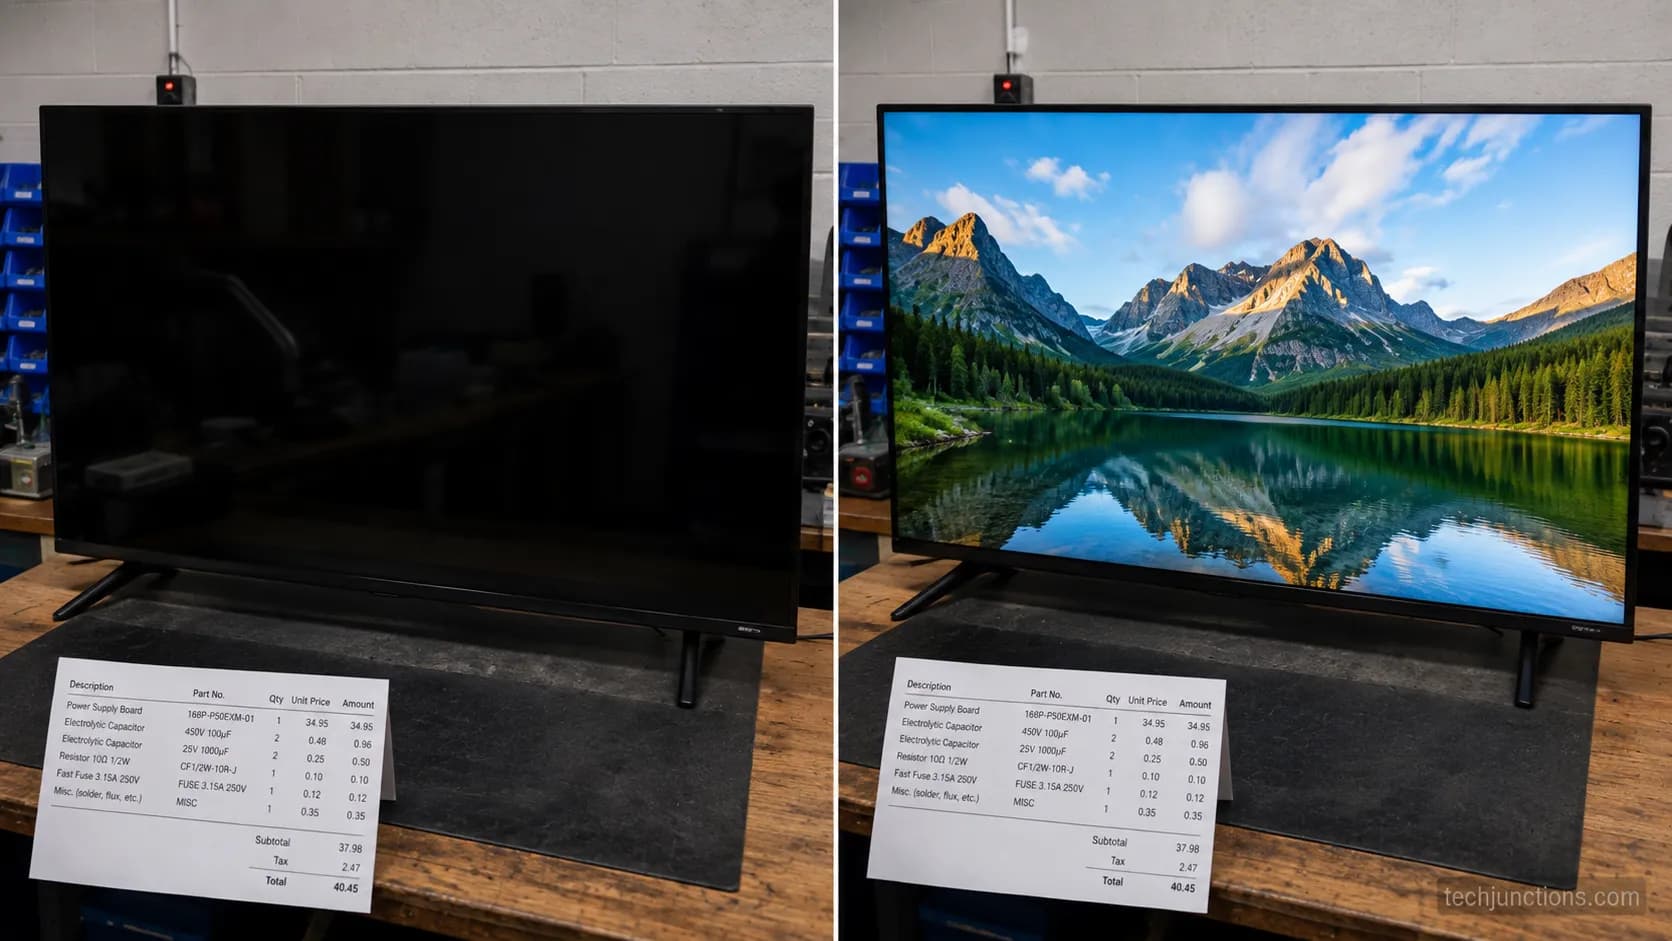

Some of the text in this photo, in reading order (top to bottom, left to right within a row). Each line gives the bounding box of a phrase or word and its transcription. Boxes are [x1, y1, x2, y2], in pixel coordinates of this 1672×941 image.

[70, 680, 114, 693] Description
[907, 680, 951, 693] Description
[193, 689, 224, 700] Part No.
[269, 694, 285, 705] Qty
[1031, 688, 1062, 700] Part No.
[1106, 694, 1120, 705] Qty
[66, 701, 143, 715] Power Supply Board
[290, 696, 330, 708] Unit Price
[342, 699, 374, 710] Amount
[904, 700, 980, 716] Power Supply Board
[1128, 696, 1168, 708] Unit Price
[1178, 699, 1212, 710] Amount
[276, 716, 281, 724] 1
[1024, 709, 1091, 724] 168P-P50EXM-01
[1113, 716, 1118, 725] 1
[1142, 717, 1167, 728] 34.95
[64, 717, 144, 734] Electrolytic Capacitor
[306, 718, 328, 729] 34.95
[350, 720, 375, 733] 34.95
[902, 717, 983, 734] Electrolytic Capacitor
[1186, 720, 1210, 733] 34.95
[185, 727, 232, 741] 450V 100µF
[274, 733, 280, 742] 2
[1021, 728, 1070, 741] 450V 100µF
[1111, 734, 1117, 742] 2
[62, 734, 142, 751] Electrolytic Capacitor
[308, 735, 326, 747] 0.48
[352, 738, 372, 750] 0.96
[899, 734, 980, 751] Electrolytic Capacitor
[1145, 736, 1165, 746] 0.48
[1191, 738, 1208, 750] 0.96
[182, 744, 229, 758] 25V 1000µF
[272, 751, 278, 760] 2
[1019, 743, 1066, 758] 25V 1000µF
[1108, 751, 1115, 760] 2
[59, 751, 131, 767] Resistor 10Ω 1/2W
[307, 753, 325, 765] 0.25
[352, 756, 370, 768] 0.50
[897, 750, 968, 767] Resistor 10Ω 1/2W
[1144, 753, 1161, 765] 0.25
[1189, 756, 1207, 768] 0.50
[56, 768, 74, 778] Fast
[75, 770, 94, 780] Fuse
[118, 774, 140, 784] 250V
[271, 768, 276, 777] 1
[305, 771, 324, 781] 0.10
[894, 768, 977, 784] Fast Fuse 3.15A 250V
[1108, 768, 1113, 777] 1
[1142, 771, 1160, 782] 0.10
[351, 775, 369, 784] 0.10
[1188, 774, 1207, 784] 0.10
[178, 779, 247, 792] FUSE 3.15A 250V
[269, 786, 274, 795] 1
[1016, 779, 1084, 792] FUSE 3.15A 250V
[1106, 786, 1111, 795] 1
[54, 785, 142, 804] Misc. (solder, flux, etc.)
[303, 788, 321, 800] 0.12
[349, 791, 367, 804] 0.12
[891, 785, 979, 804] Misc. (solder, flux, etc.)
[1140, 788, 1158, 800] 0.12
[1186, 792, 1205, 804] 0.12
[176, 797, 198, 808] MISC
[1013, 796, 1035, 807] MISC
[267, 803, 272, 813] 1
[301, 806, 320, 817] 0.35
[1104, 804, 1109, 813] 1
[1138, 807, 1156, 817] 0.35
[347, 809, 366, 820] 0.35
[1184, 809, 1202, 821] 0.35
[255, 835, 291, 848] Subtotal
[1092, 835, 1128, 848] Subtotal
[339, 843, 363, 855] 37.98
[1176, 842, 1199, 855] 37.98
[273, 856, 288, 868] Tax
[342, 862, 360, 872] 2.47
[1111, 856, 1125, 866] Tax
[1179, 861, 1198, 872] 2.47
[266, 875, 287, 887] Total
[1102, 876, 1124, 886] Total
[1171, 881, 1196, 893] 40.45
[333, 882, 360, 893] 40.45
